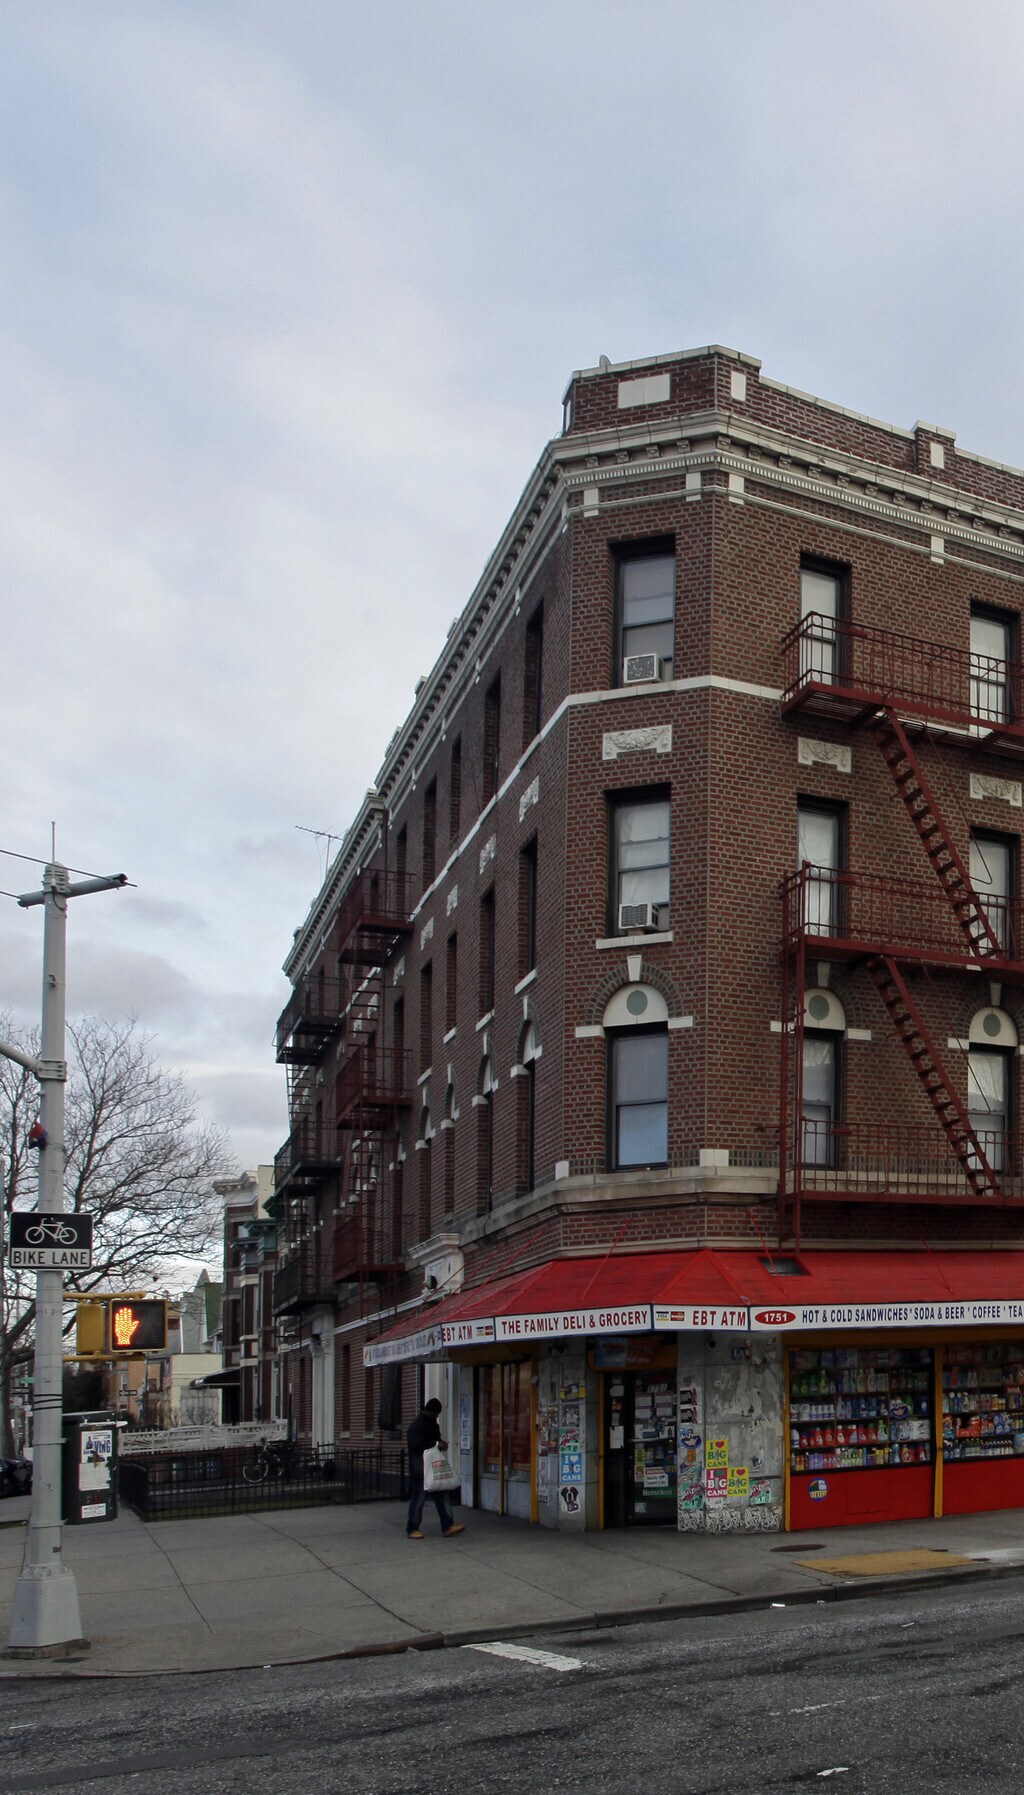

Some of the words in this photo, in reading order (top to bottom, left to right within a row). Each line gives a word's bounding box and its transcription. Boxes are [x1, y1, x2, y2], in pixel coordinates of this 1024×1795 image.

[13, 1251, 45, 1264] BIKE
[52, 1251, 87, 1265] LANE
[692, 1310, 717, 1326] EBT
[720, 1311, 746, 1326] ATM
[763, 1312, 788, 1322] 1751
[802, 1309, 820, 1323] HOT
[822, 1309, 828, 1323] &
[830, 1308, 853, 1322] COLD
[855, 1307, 908, 1322] SANDWICHES
[914, 1306, 935, 1320] SODA
[937, 1306, 943, 1319] &
[945, 1305, 965, 1319] BEER
[972, 1305, 1001, 1319] COFFEE
[1008, 1305, 1023, 1318] TEA
[501, 1319, 521, 1334] THE
[524, 1316, 559, 1333] FAMILY
[563, 1315, 586, 1330] DELI
[589, 1314, 596, 1328] &
[599, 1310, 648, 1327] GROCERY
[441, 1326, 455, 1342] EBT
[458, 1325, 473, 1341] ATM
[707, 1460, 727, 1468] CANS
[642, 1488, 673, 1496] Heineken
[707, 1489, 727, 1497] CANS
